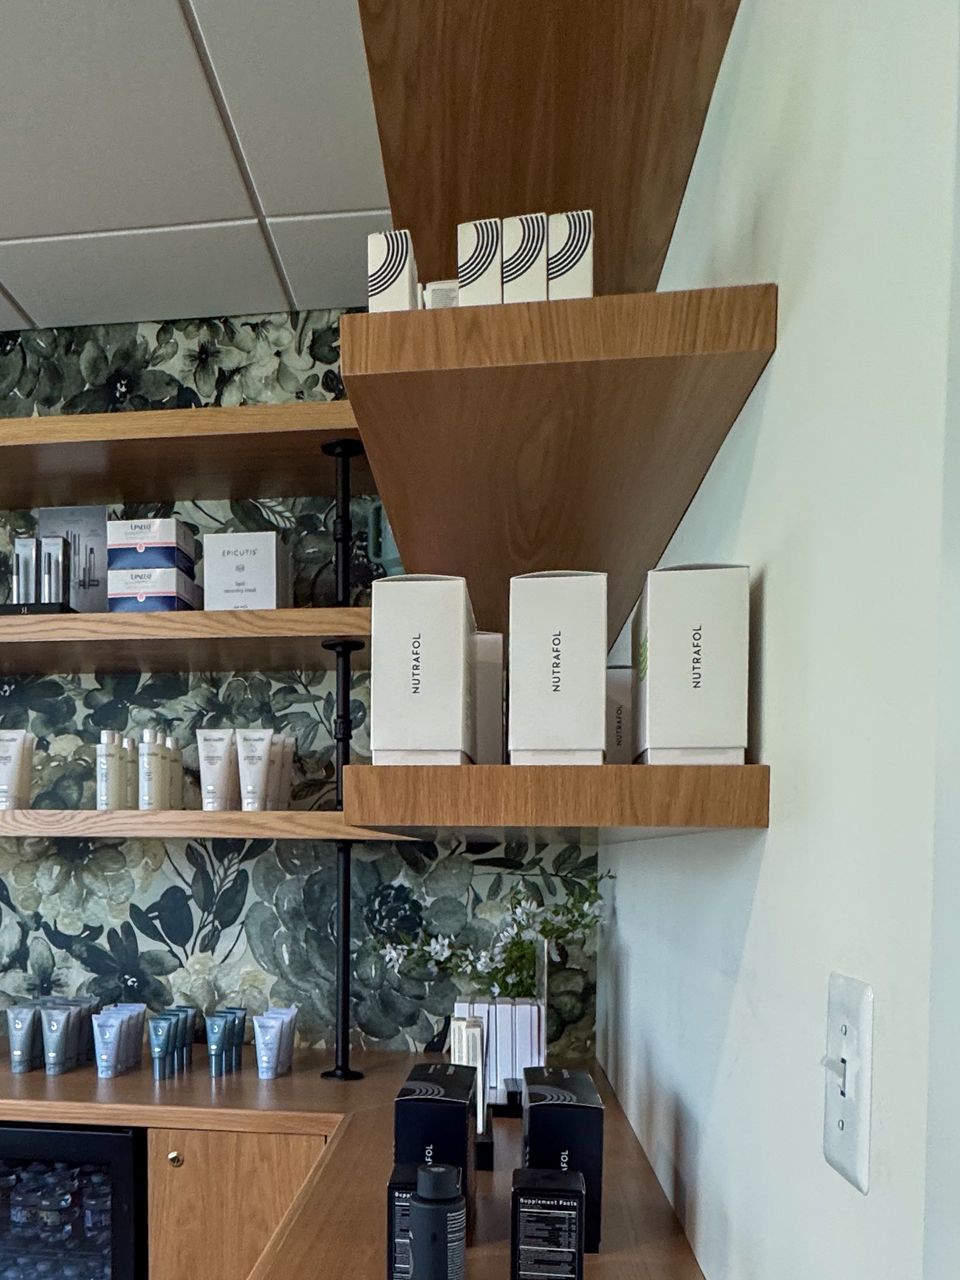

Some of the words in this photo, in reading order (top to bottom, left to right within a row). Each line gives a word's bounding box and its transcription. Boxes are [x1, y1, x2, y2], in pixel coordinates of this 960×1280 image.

[412, 633, 422, 694] NUTRAFOL
[552, 630, 562, 692] NUTRAFOL
[692, 625, 703, 689] NUTRAFOL
[519, 1197, 558, 1206] Supplement
